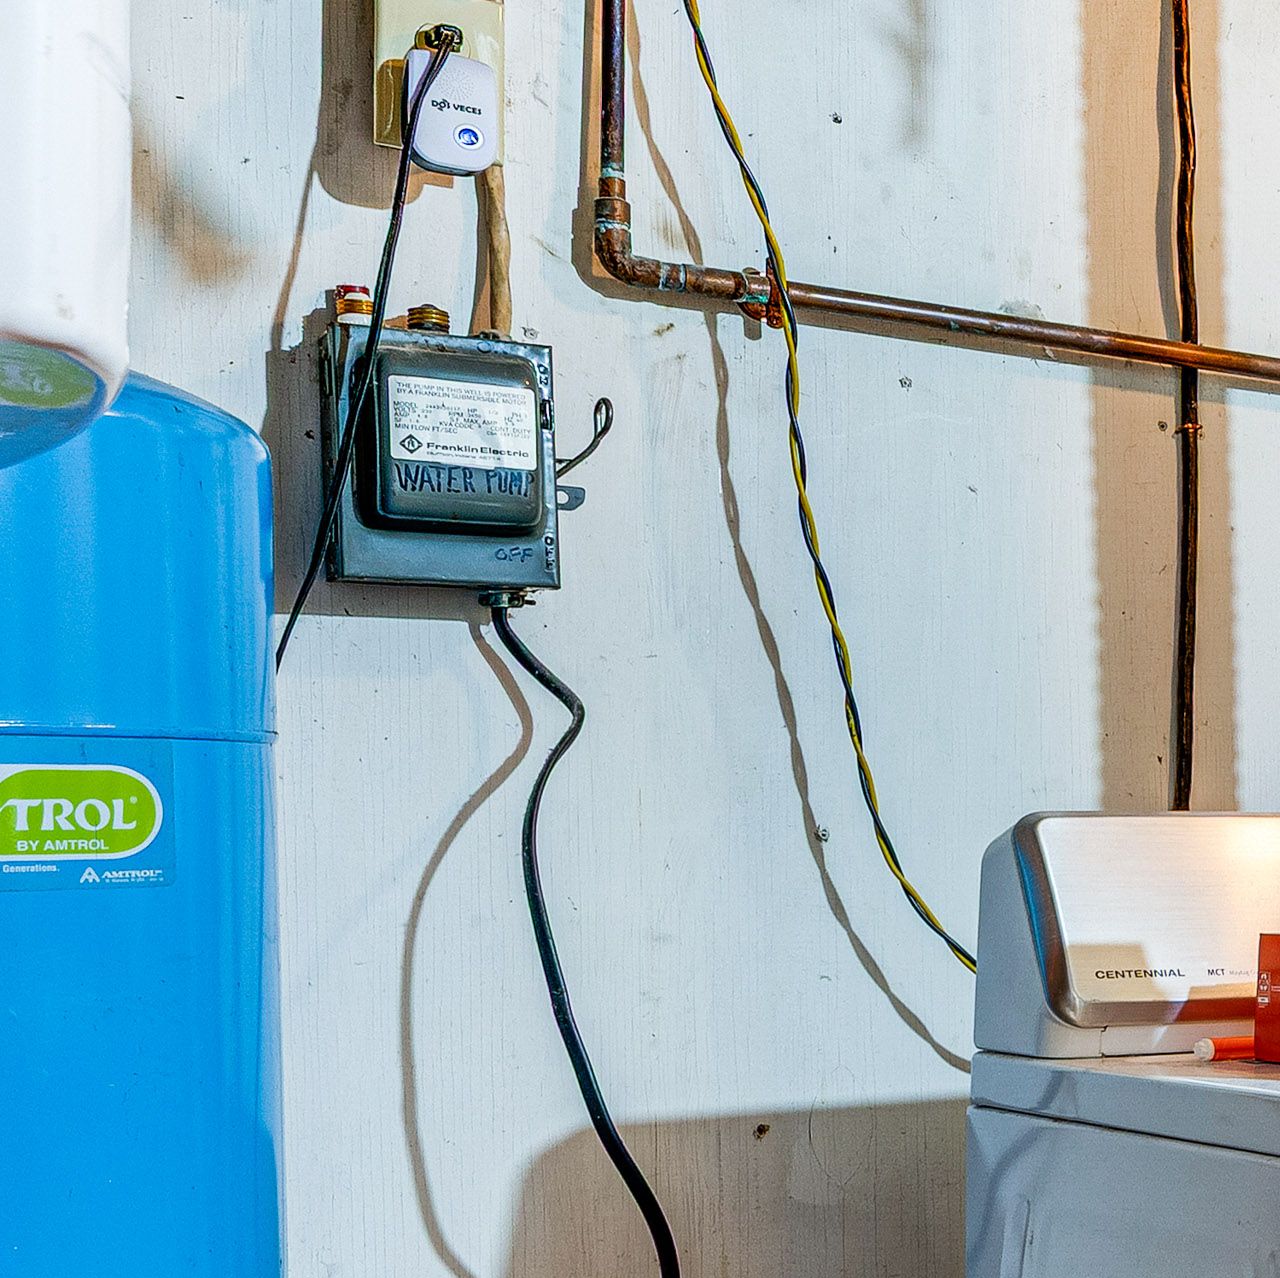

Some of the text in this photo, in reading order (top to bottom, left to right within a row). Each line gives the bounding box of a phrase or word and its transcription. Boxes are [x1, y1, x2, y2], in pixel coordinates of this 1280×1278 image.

[427, 442, 478, 454] Franklin
[480, 447, 528, 457] Electric
[395, 463, 535, 497] WATER PUMP
[495, 547, 533, 563] OFF
[17, 839, 109, 851] BY AMTROL
[1095, 968, 1225, 980] CENTENNIAL MCT
